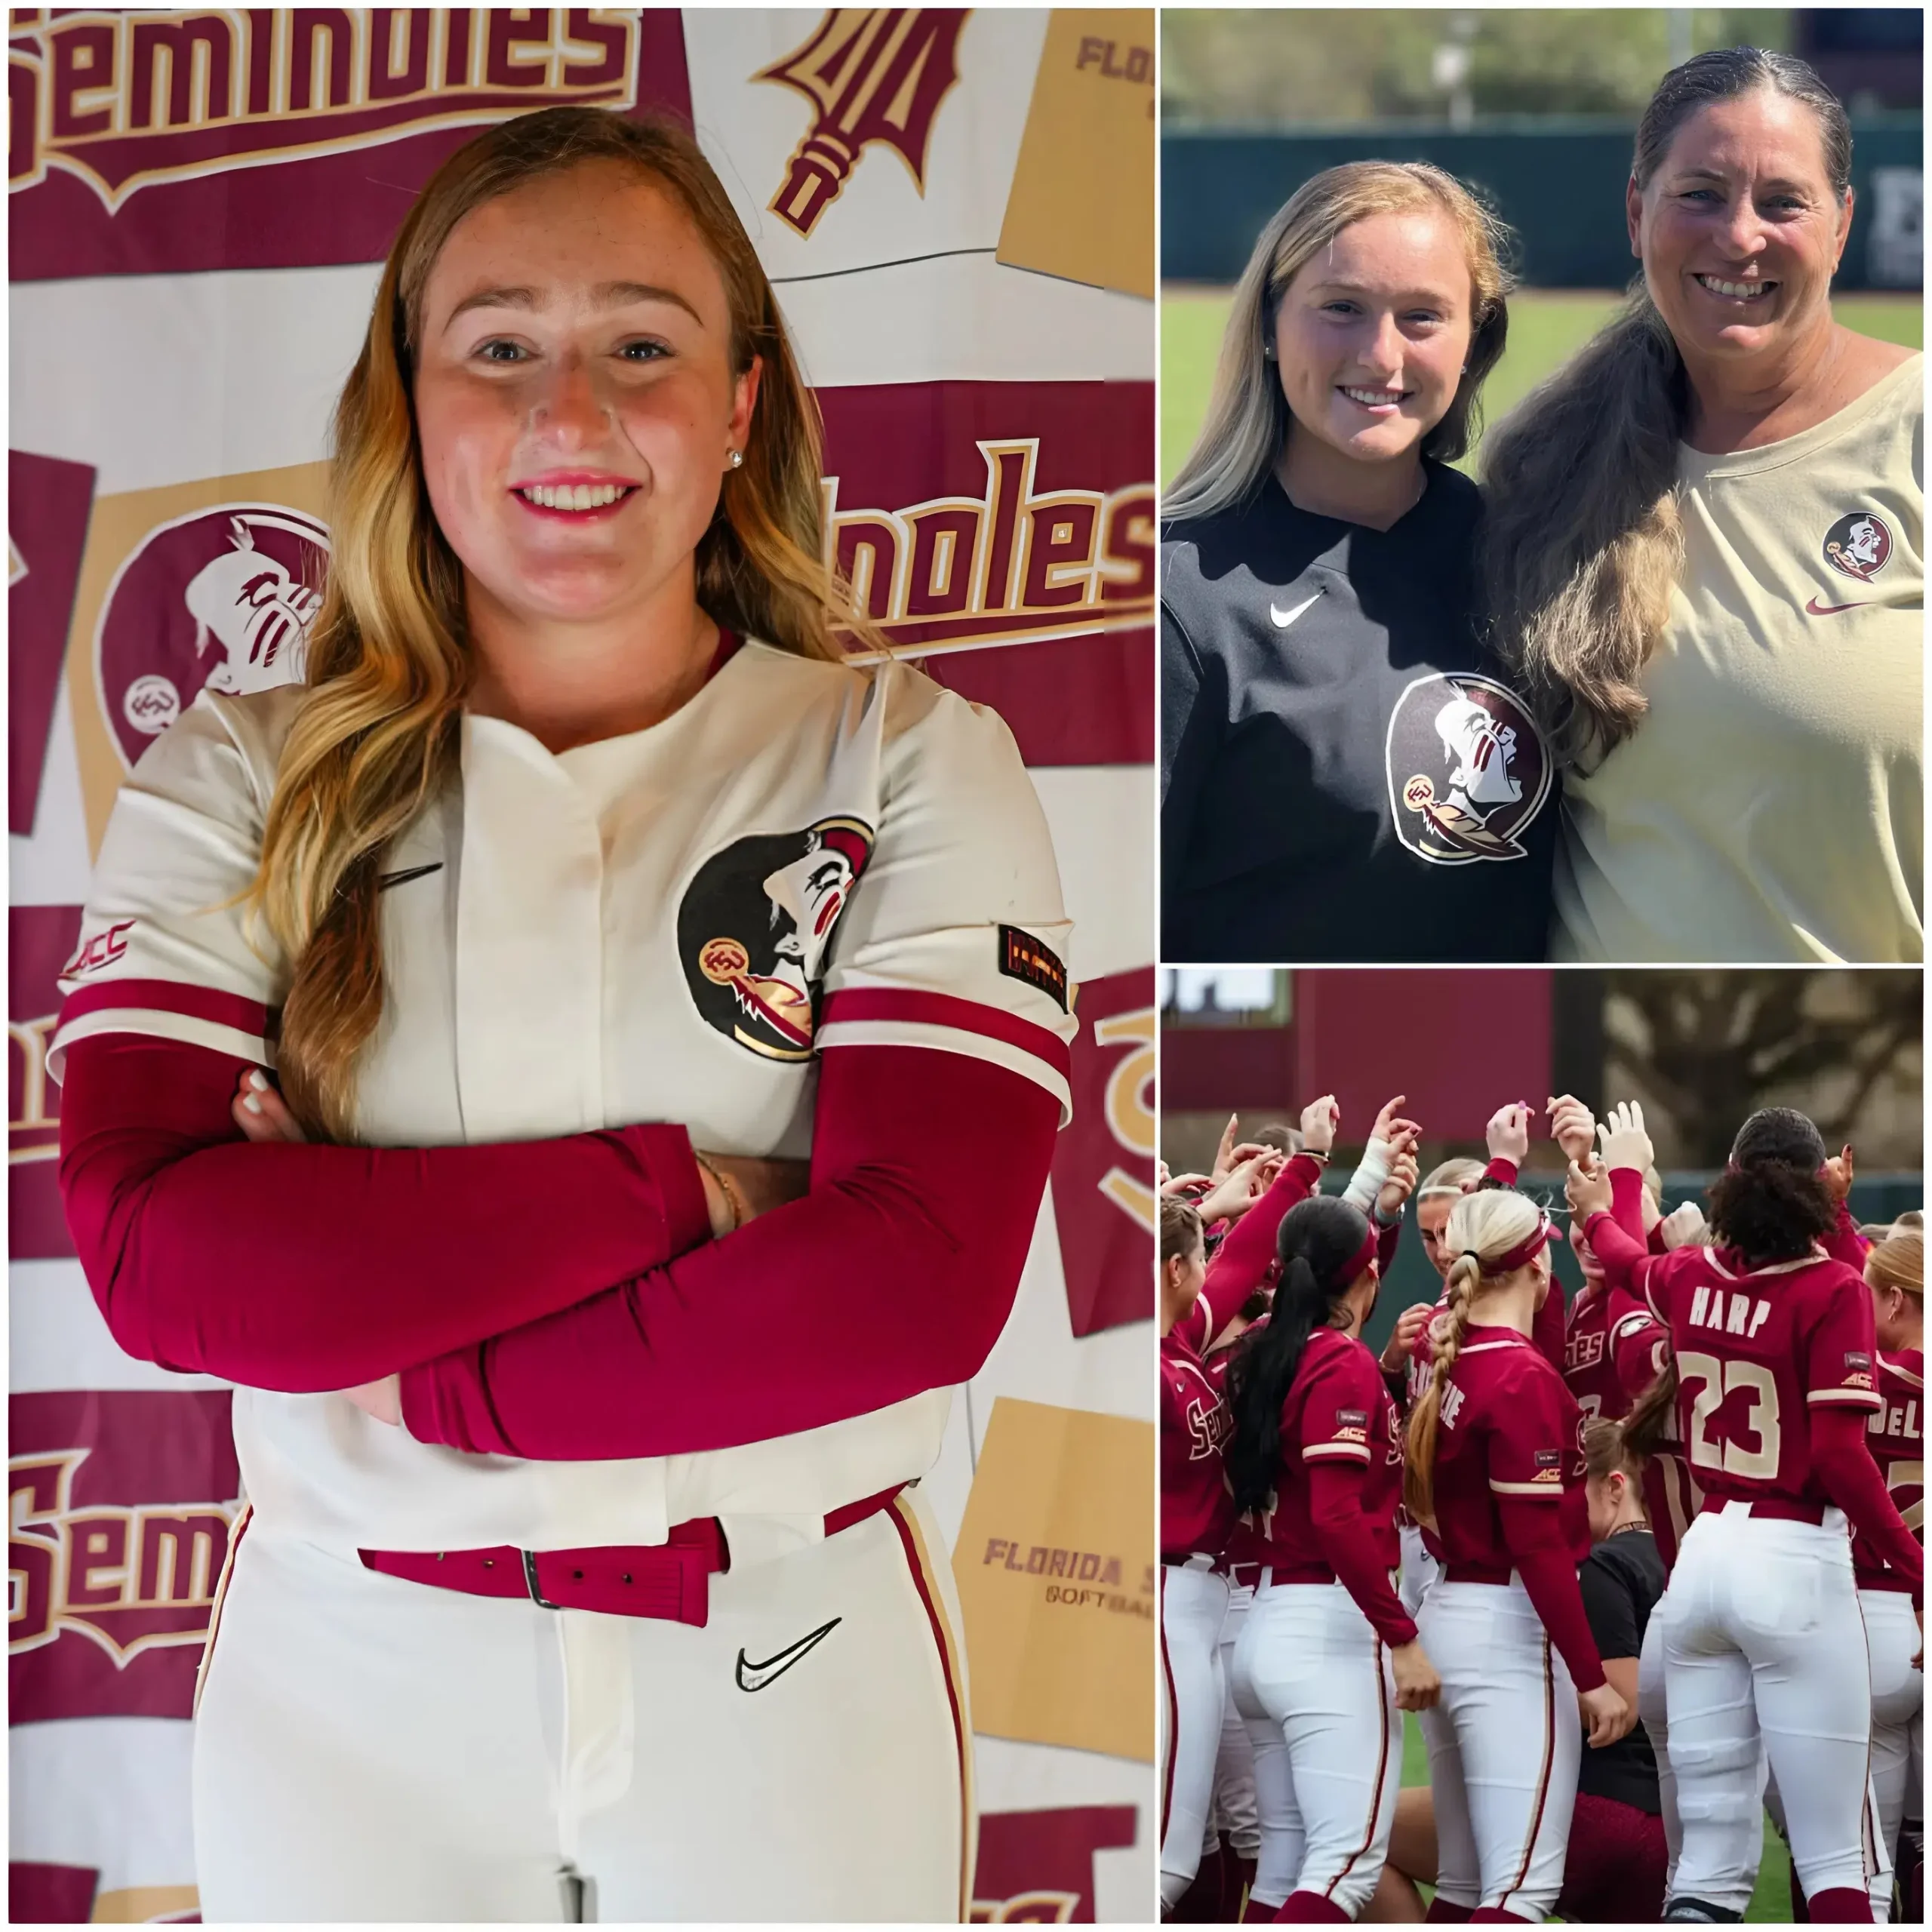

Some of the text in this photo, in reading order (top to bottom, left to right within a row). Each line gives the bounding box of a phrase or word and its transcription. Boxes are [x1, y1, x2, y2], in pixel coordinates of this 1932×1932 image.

[1075, 35, 1155, 87] FLO
[822, 438, 1155, 630] noles
[1407, 783, 1432, 802] FSU
[1688, 1285, 1772, 1339] HARP
[1675, 1350, 1781, 1480] 23
[983, 1537, 1121, 1587] FLORIDA
